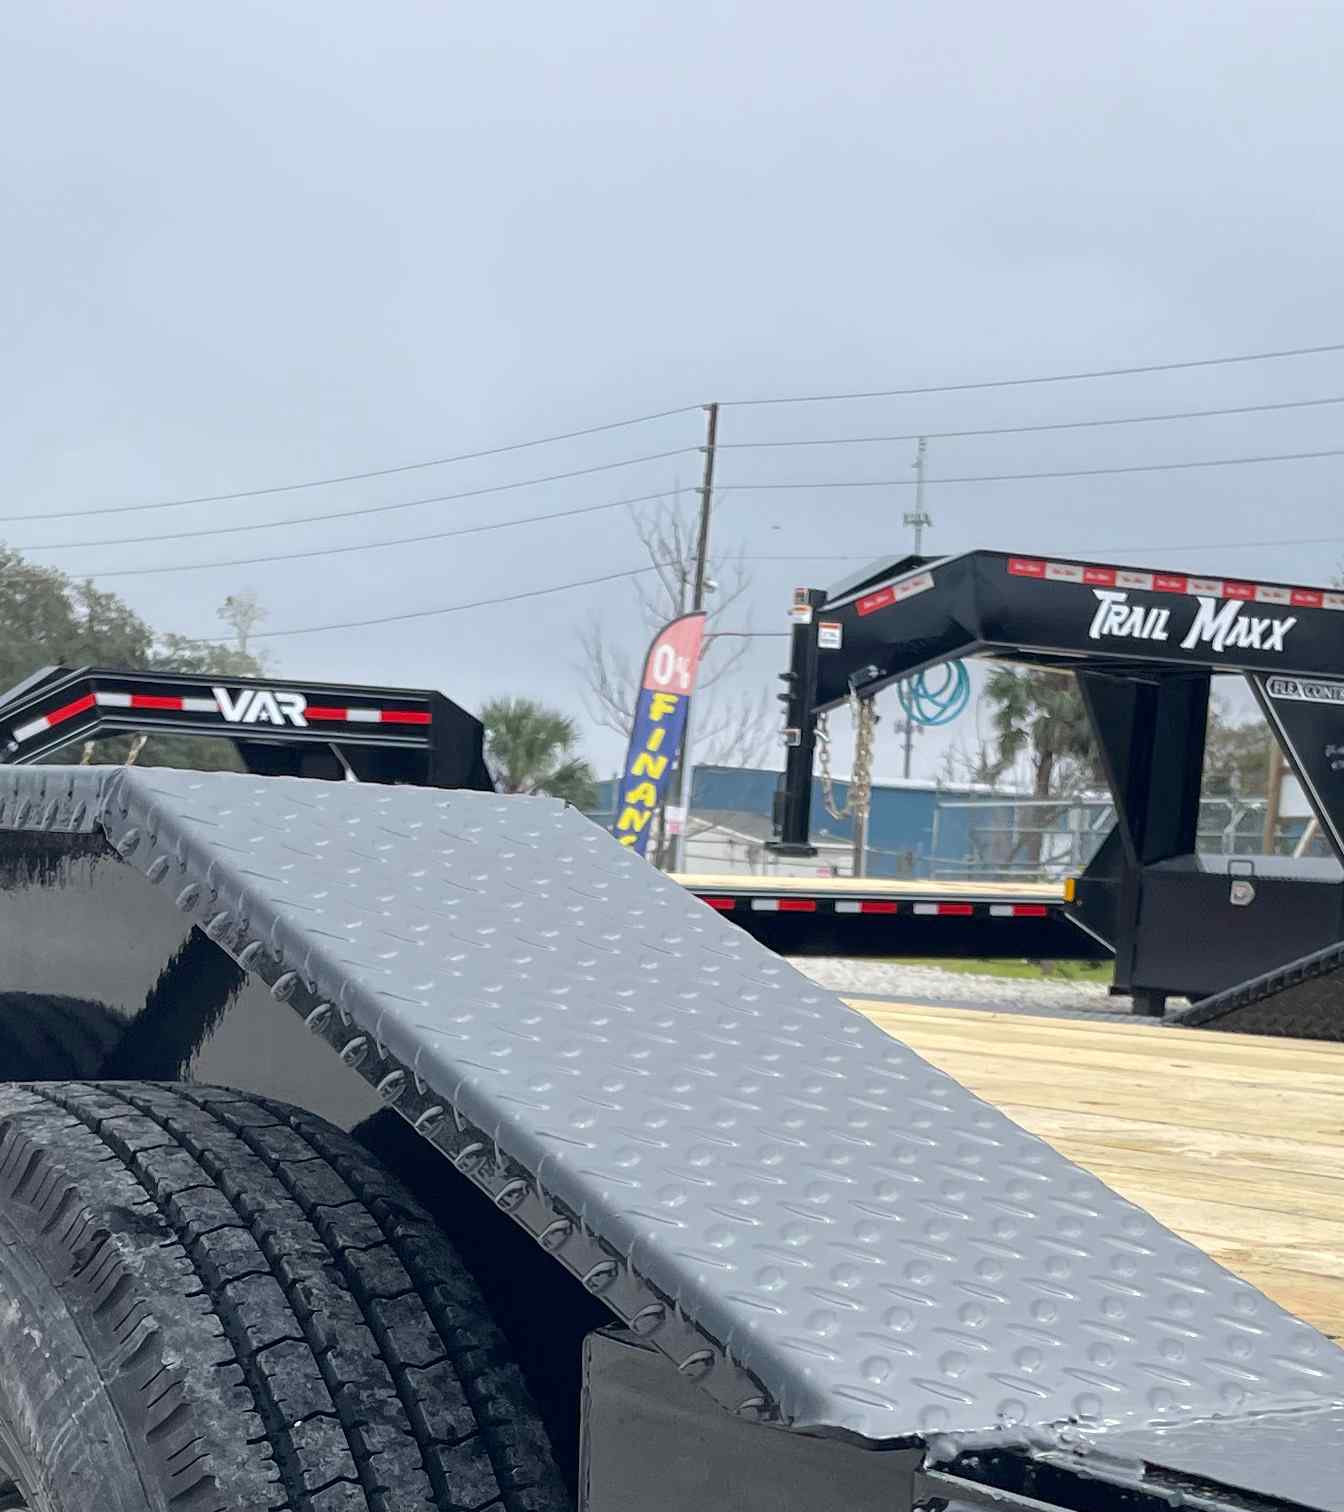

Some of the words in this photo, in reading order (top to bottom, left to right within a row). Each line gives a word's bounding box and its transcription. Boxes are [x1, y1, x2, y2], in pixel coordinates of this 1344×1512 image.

[1089, 589, 1170, 641] TRAIL
[1180, 596, 1298, 653] MAXX
[652, 643, 691, 689] 0%
[211, 687, 310, 727] VAR
